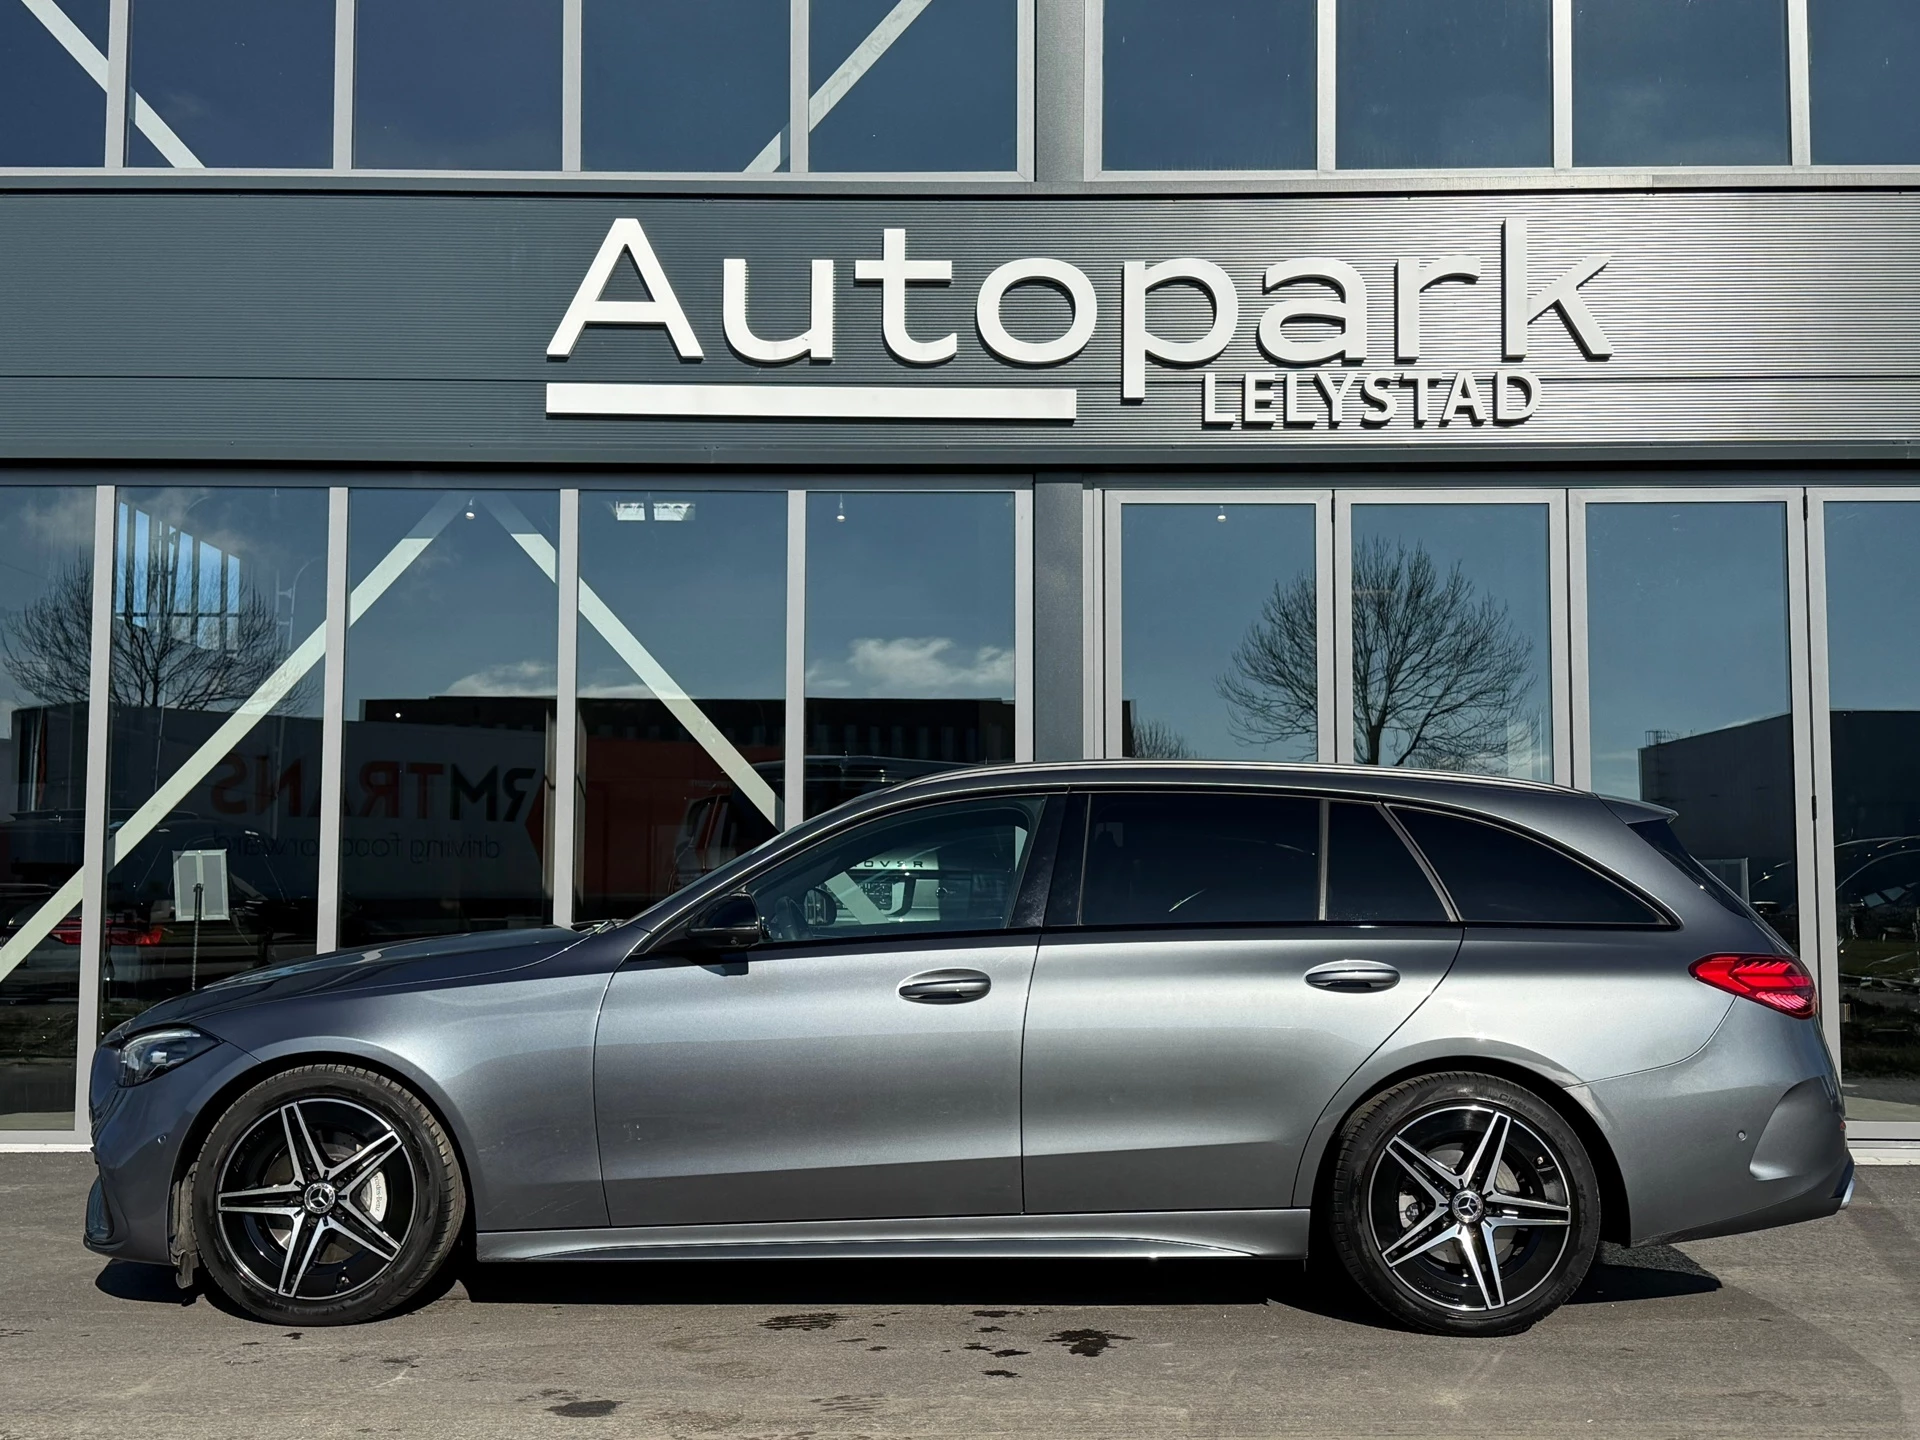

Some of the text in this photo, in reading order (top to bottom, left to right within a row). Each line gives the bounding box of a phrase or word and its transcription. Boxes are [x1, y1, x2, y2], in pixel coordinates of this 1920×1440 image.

[546, 218, 1613, 402] Autopark
[1202, 370, 1542, 426] LELYSTAD
[855, 860, 923, 868] OVER
[374, 1175, 382, 1212] rcedes-Benz
